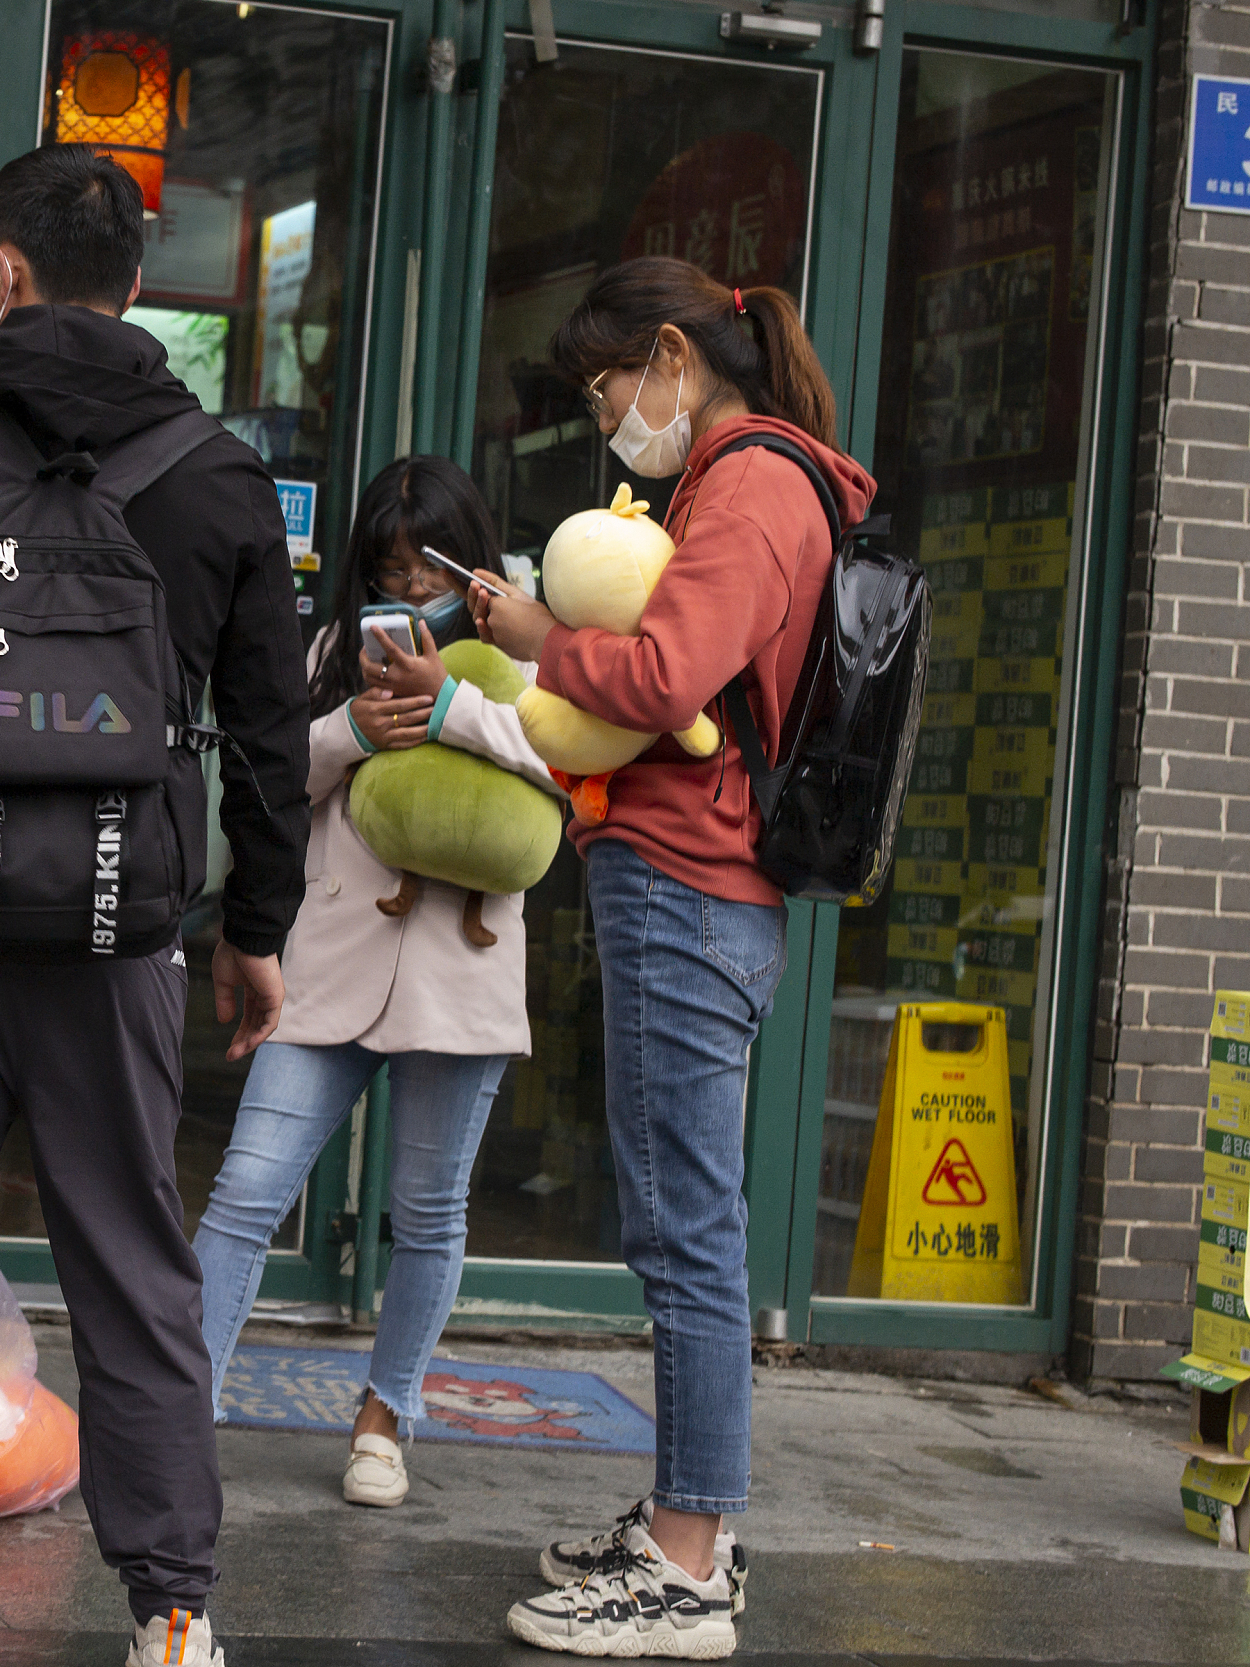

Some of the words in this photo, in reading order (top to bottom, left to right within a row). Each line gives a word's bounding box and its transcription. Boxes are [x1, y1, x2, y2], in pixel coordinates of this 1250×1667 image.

[1217, 91, 1239, 115] 民
[1206, 178, 1250, 197] 邮政编
[920, 1092, 986, 1109] CAUTION
[912, 1107, 941, 1122] WET
[949, 1109, 997, 1124] FLOOR
[907, 1220, 1000, 1260] 小心地滑
